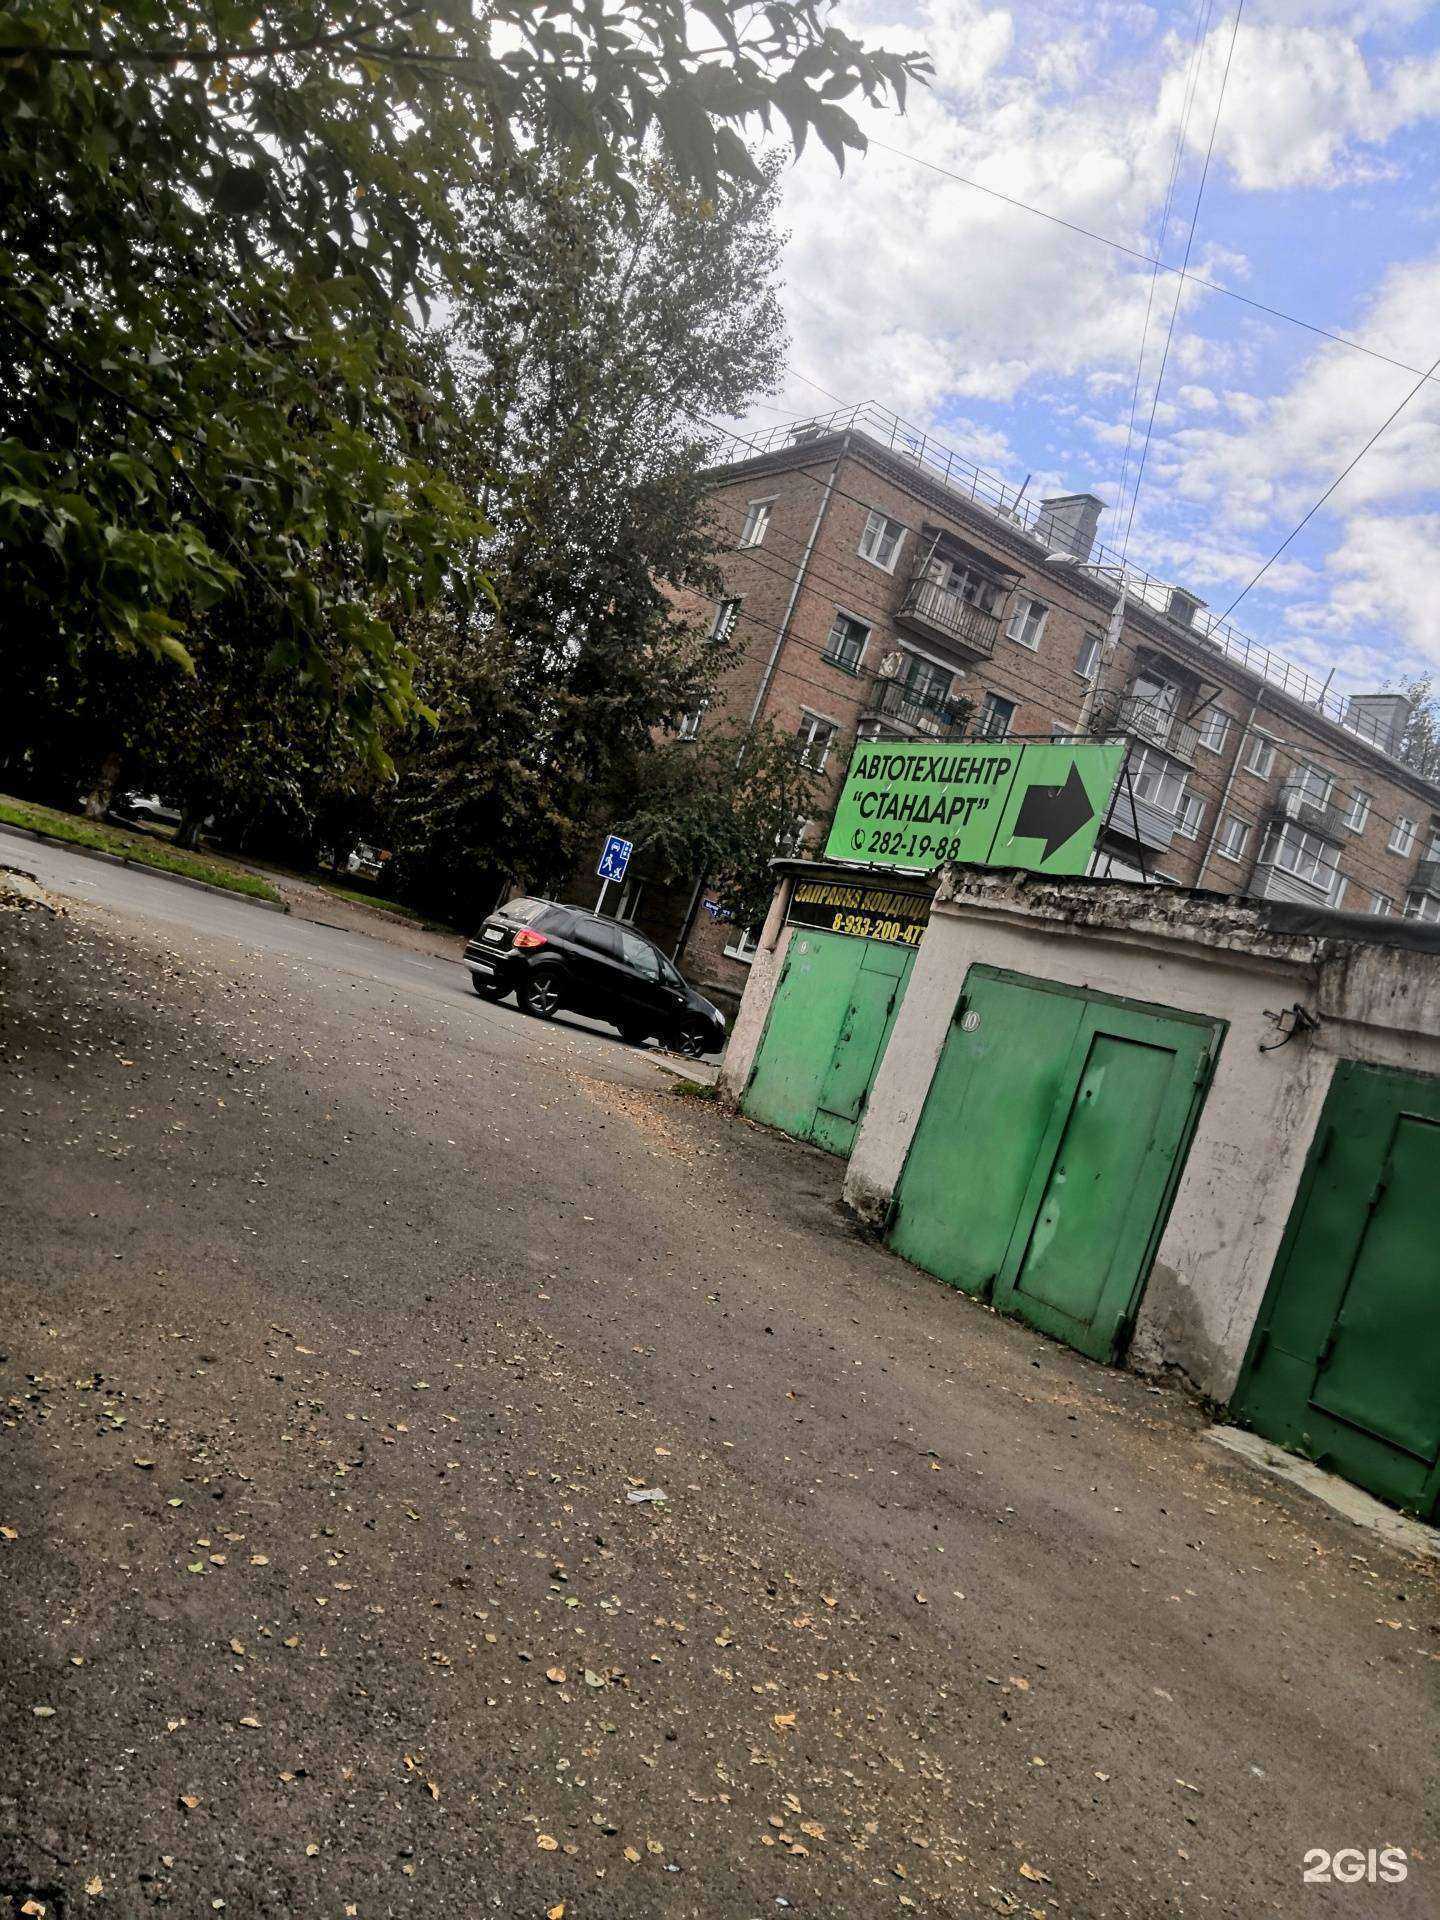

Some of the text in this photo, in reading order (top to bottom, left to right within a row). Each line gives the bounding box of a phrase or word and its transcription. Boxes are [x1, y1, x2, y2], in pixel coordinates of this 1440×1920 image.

[853, 755, 1012, 785] АВТОТЕХЦЕНТР
[868, 829, 961, 860] 282-19-88
[794, 883, 863, 909] ЗАПРАВКА
[964, 1011, 977, 1029] 10
